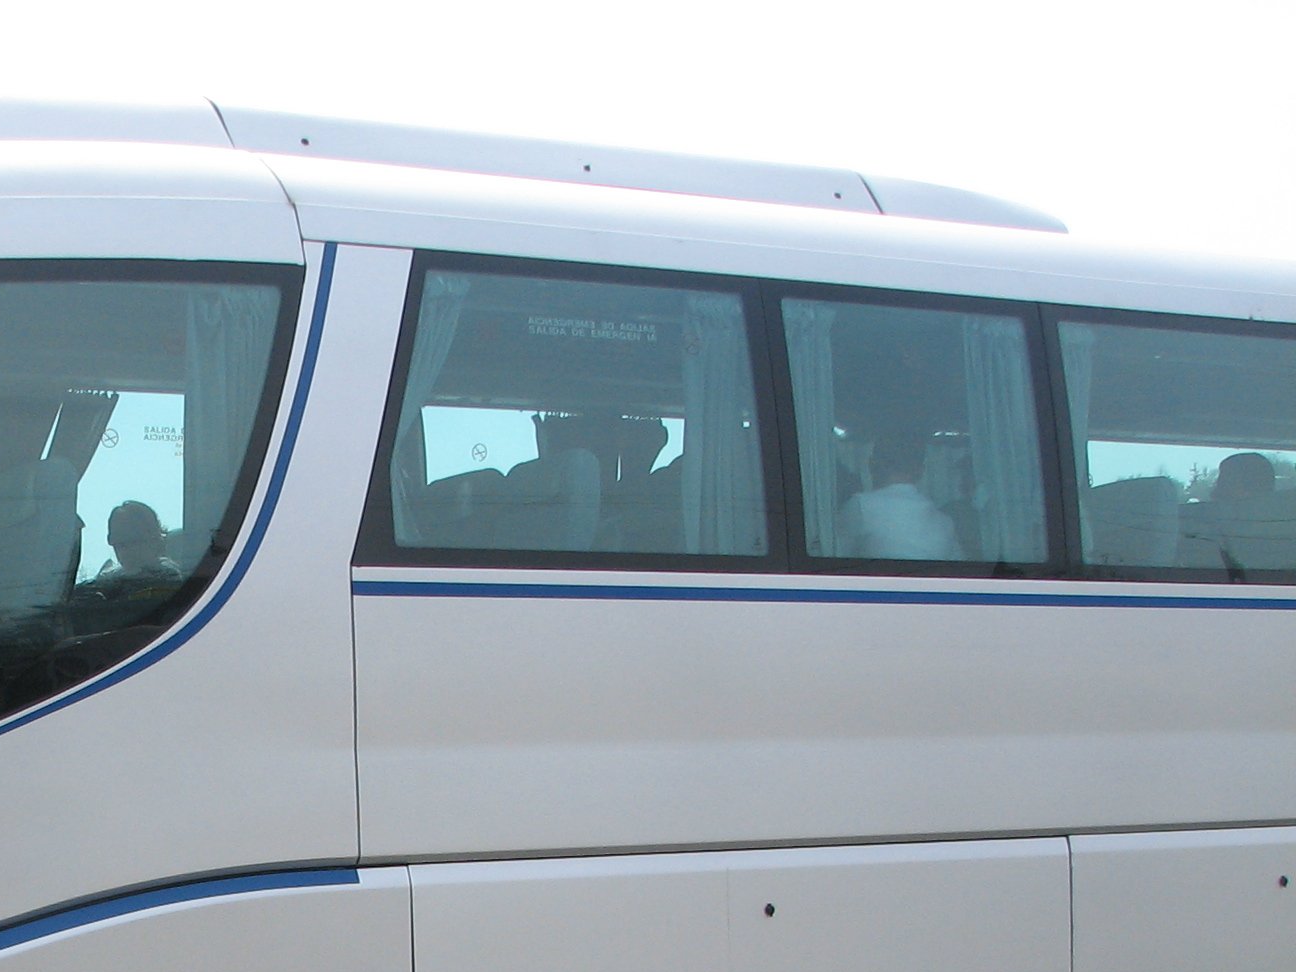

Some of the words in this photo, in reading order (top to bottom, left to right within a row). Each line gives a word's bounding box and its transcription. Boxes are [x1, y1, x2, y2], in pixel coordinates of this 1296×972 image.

[528, 325, 567, 336] SALIDA
[571, 328, 585, 337] DE
[591, 330, 657, 341] EMERGENIA
